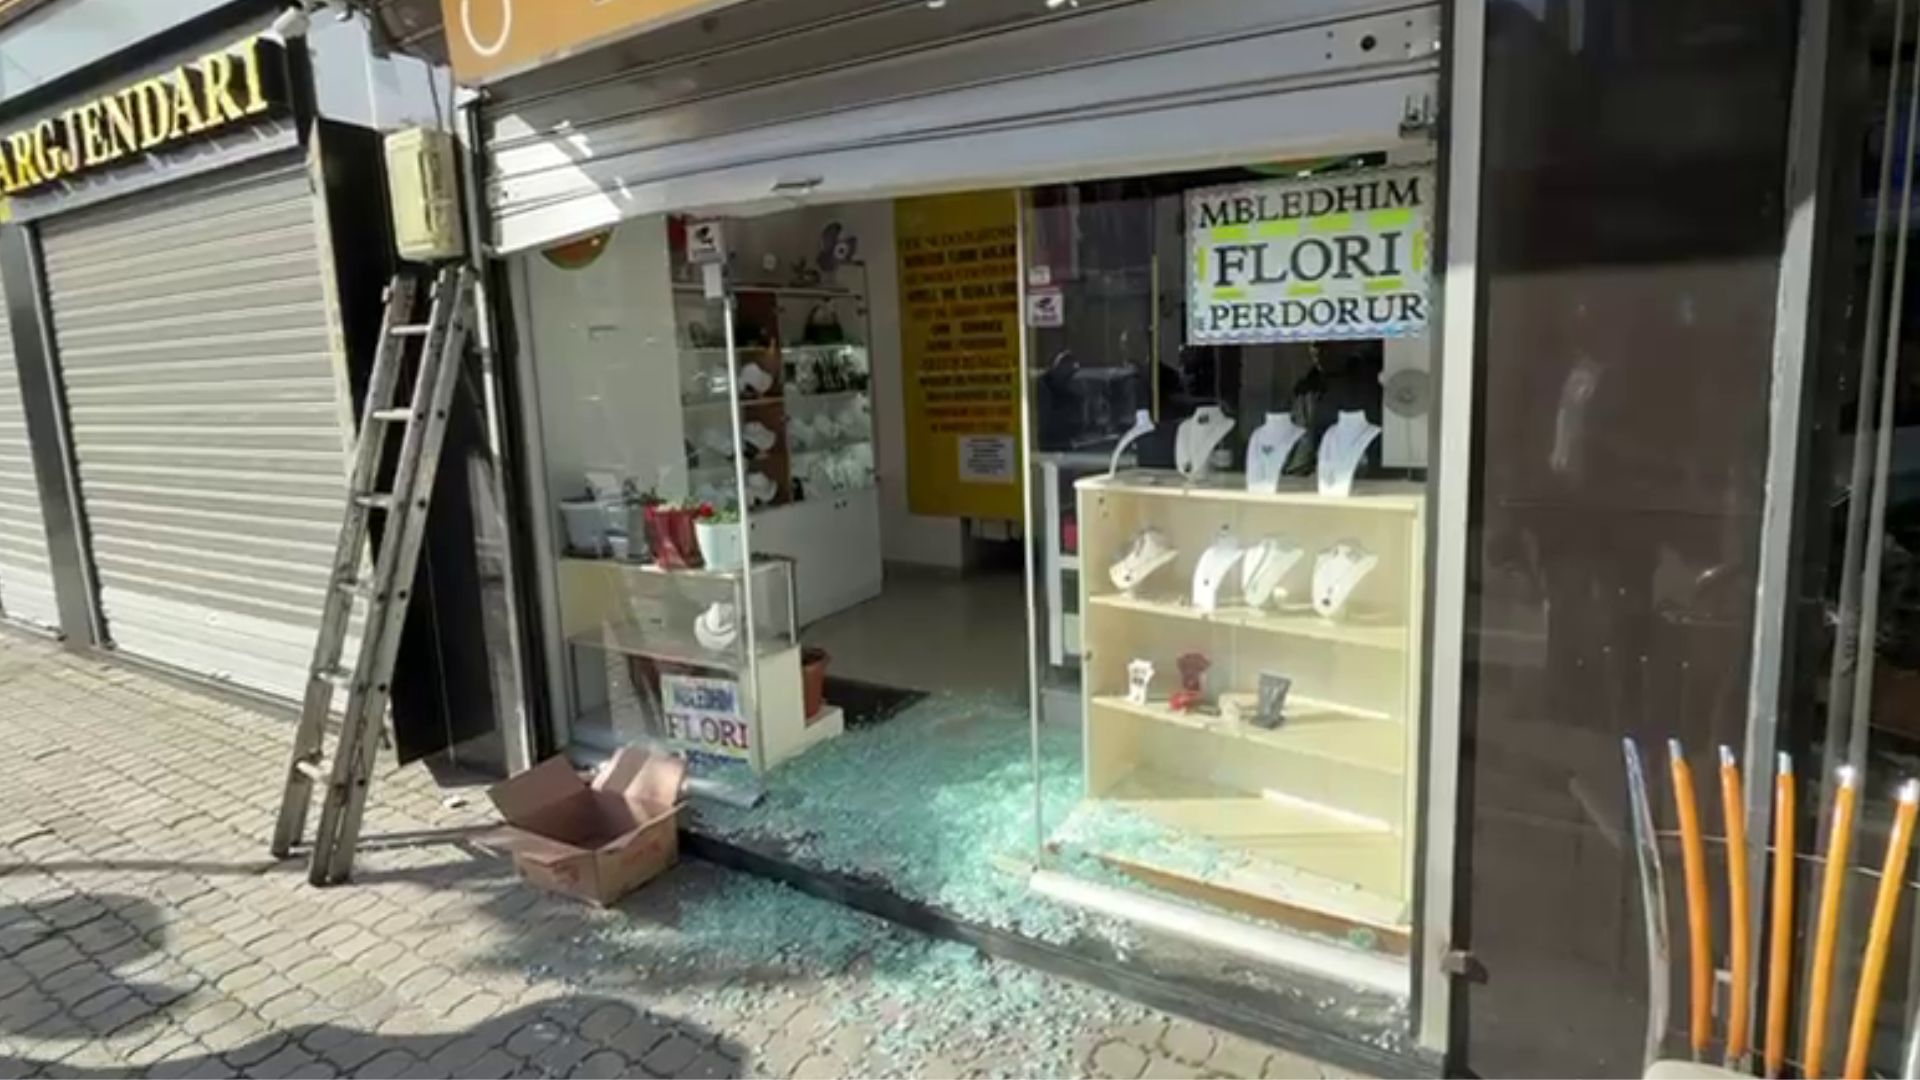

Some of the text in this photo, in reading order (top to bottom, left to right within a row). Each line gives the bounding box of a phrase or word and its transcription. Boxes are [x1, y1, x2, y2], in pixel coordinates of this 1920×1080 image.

[1200, 176, 1421, 229] MBLEDHIM
[1213, 230, 1402, 287] FLORI
[1209, 292, 1425, 331] PERDORUR
[666, 713, 749, 749] FLORI
